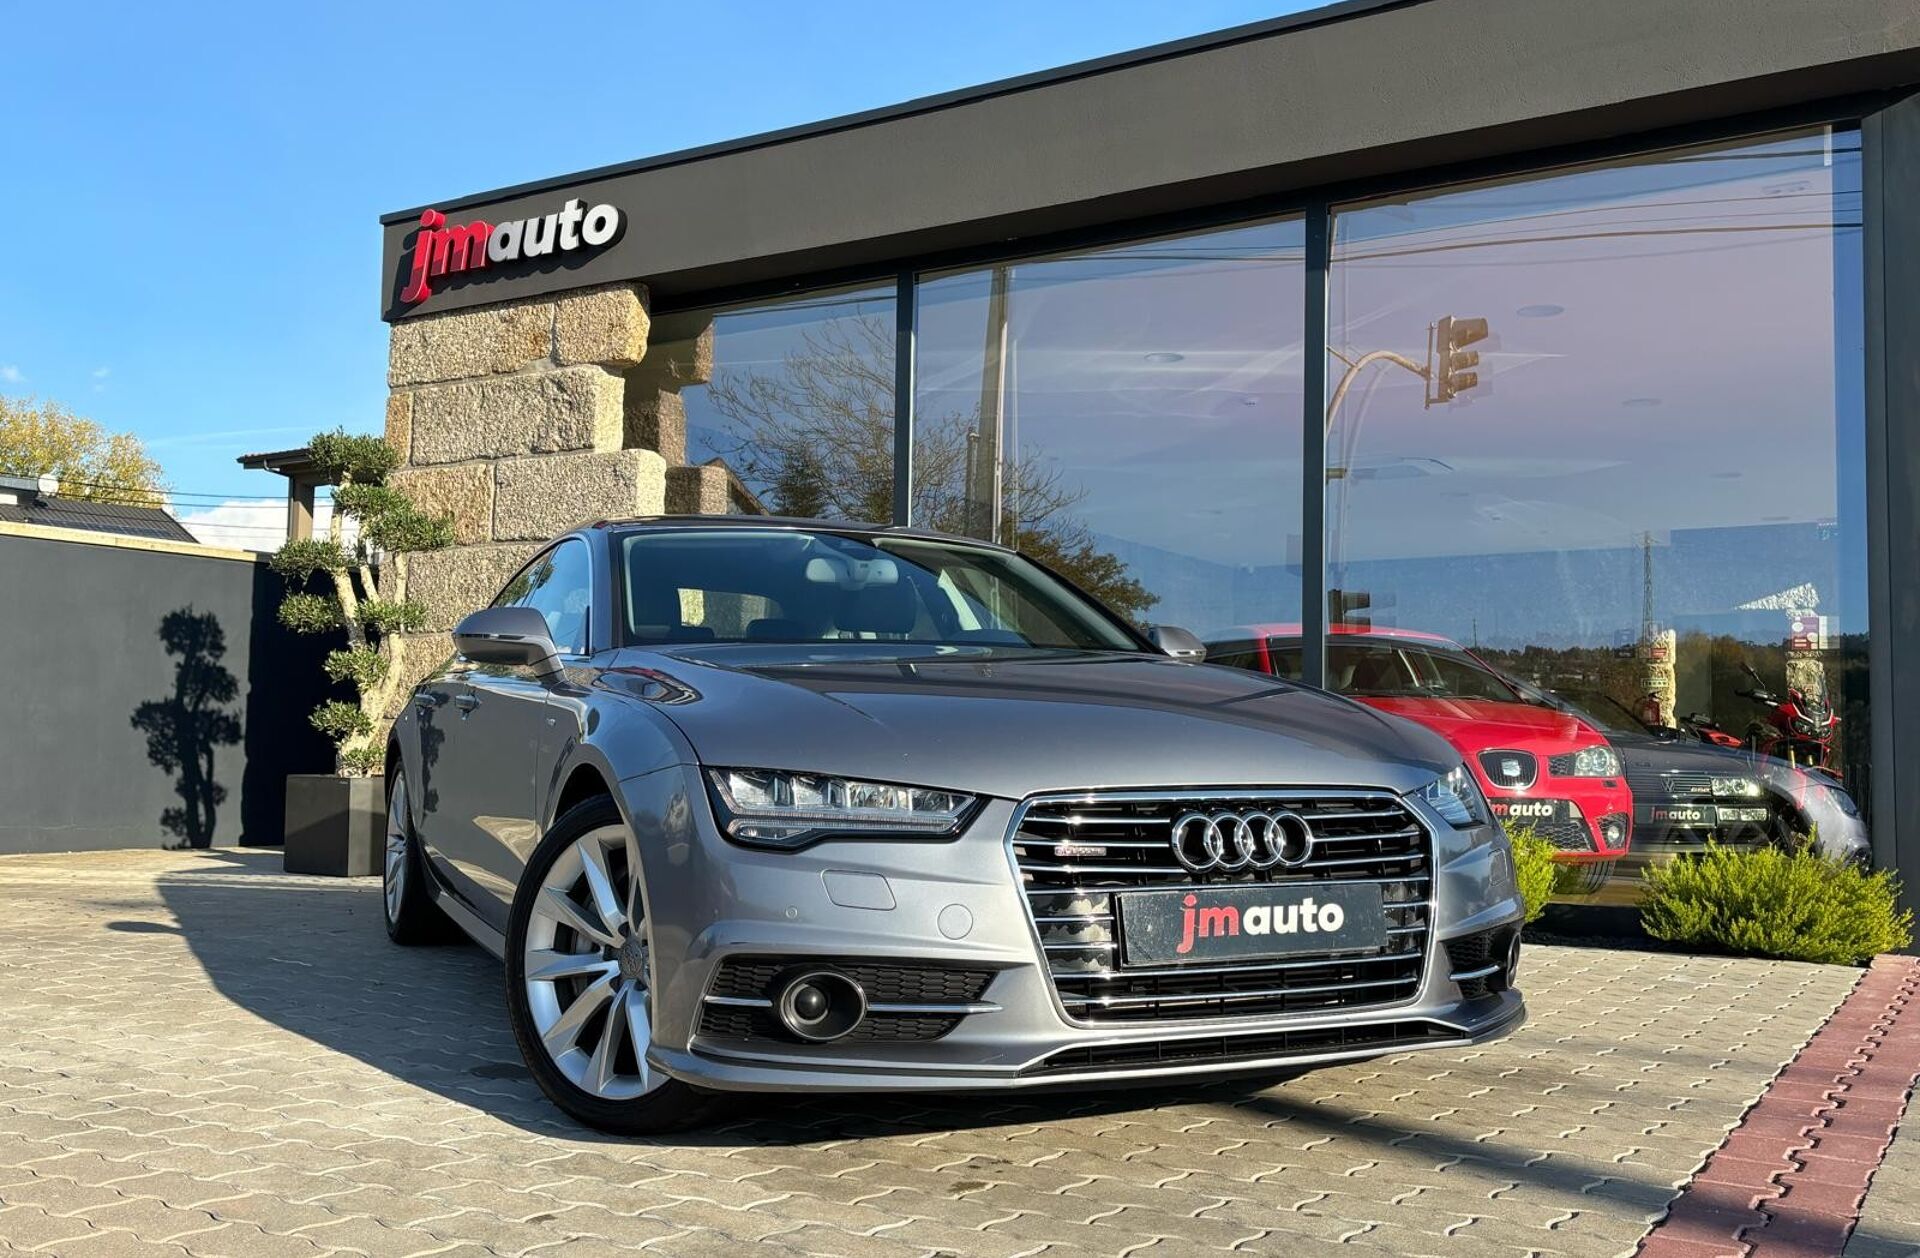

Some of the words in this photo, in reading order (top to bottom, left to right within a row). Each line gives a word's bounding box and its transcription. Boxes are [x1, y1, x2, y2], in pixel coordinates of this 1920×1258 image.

[400, 198, 619, 304] jmauto
[1491, 801, 1553, 816] mauto
[1176, 894, 1344, 953] jmauto
